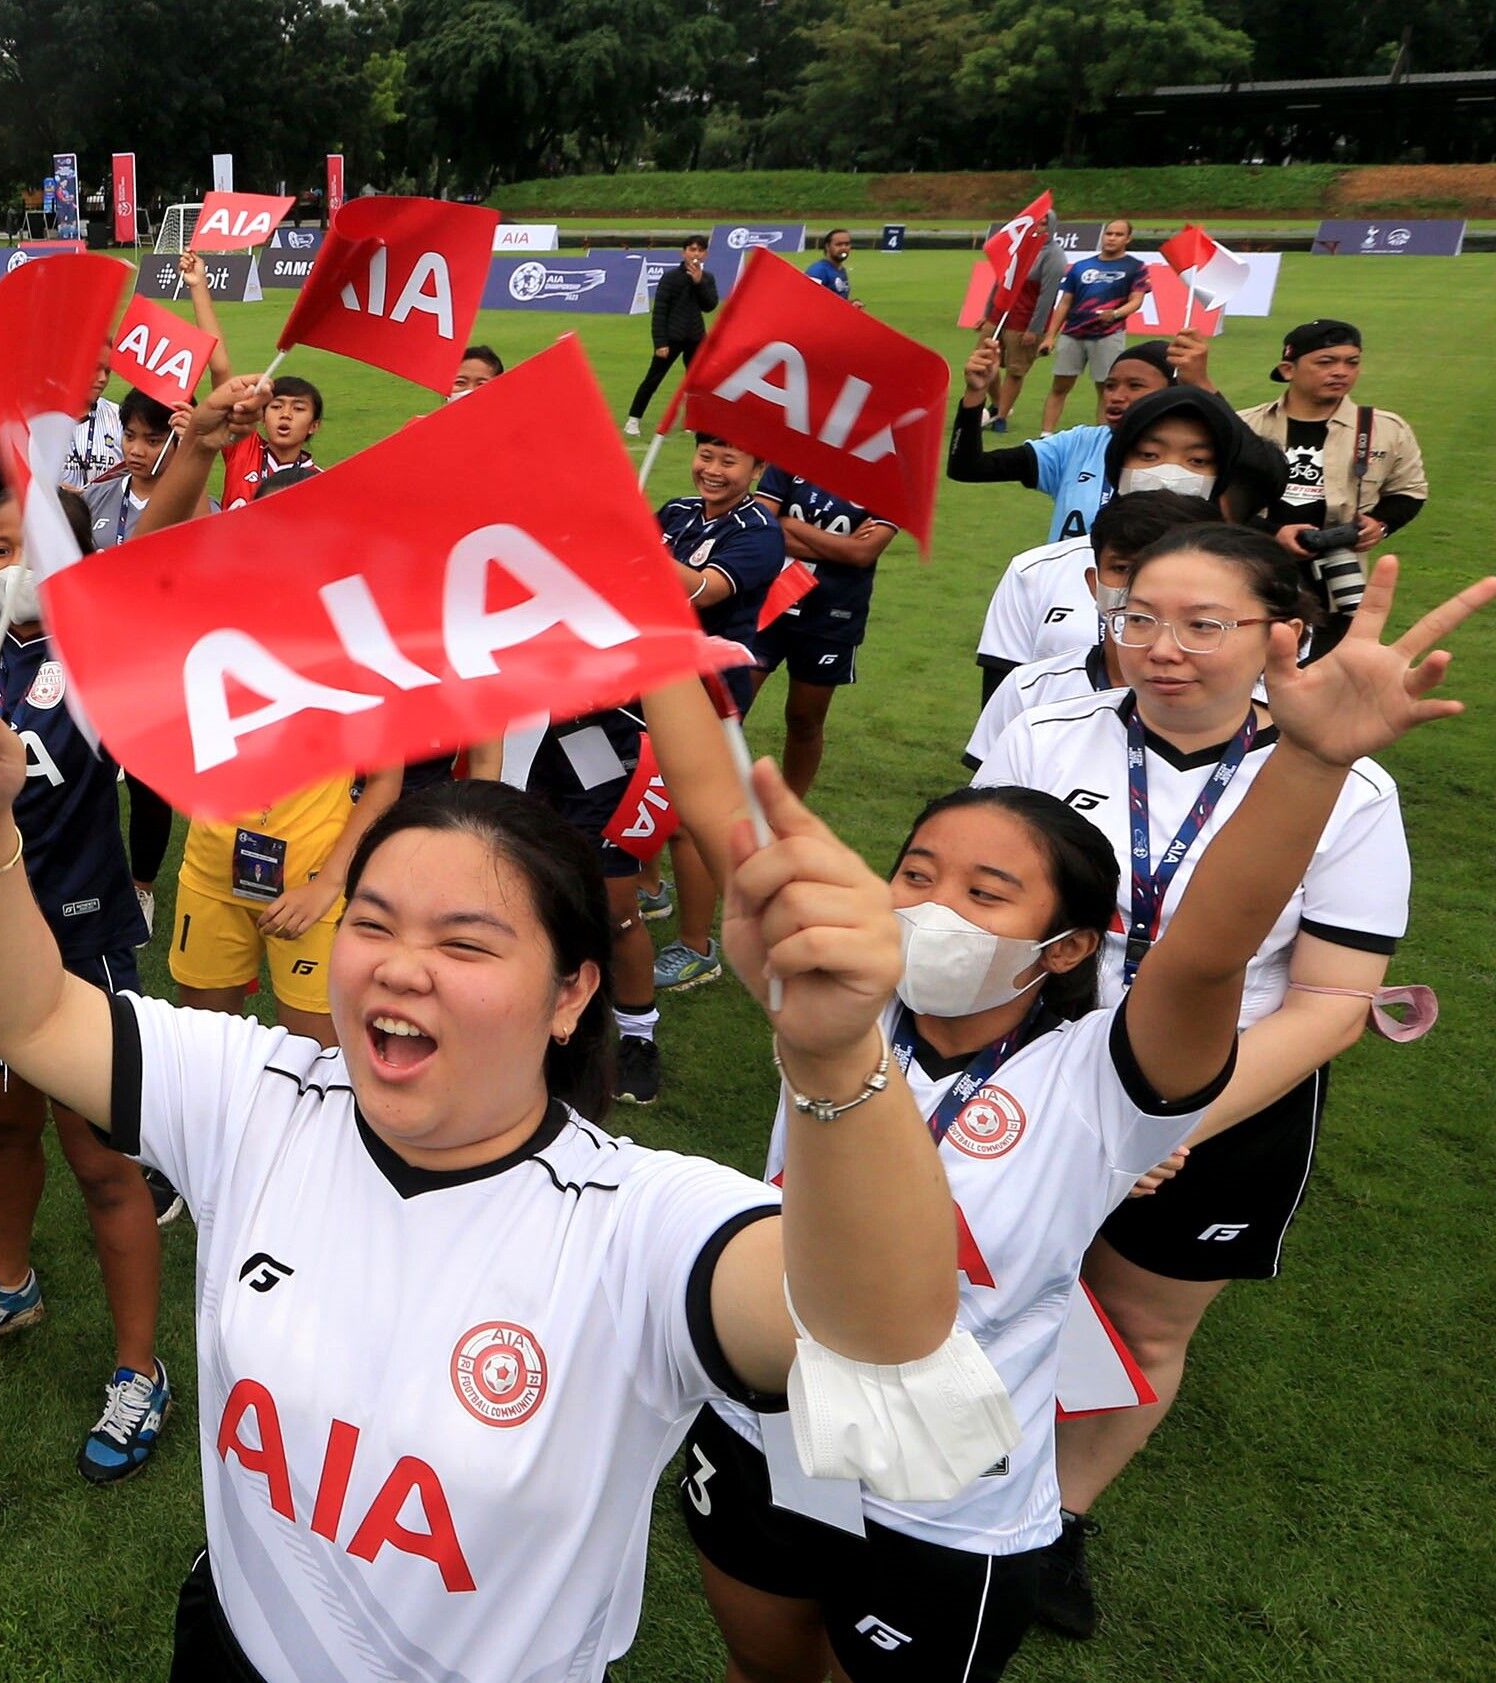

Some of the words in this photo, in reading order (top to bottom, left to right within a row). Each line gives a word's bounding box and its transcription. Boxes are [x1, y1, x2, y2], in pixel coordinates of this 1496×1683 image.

[199, 208, 271, 236] AIA
[502, 232, 529, 244] AIA
[888, 236, 898, 248] 4
[1000, 215, 1035, 291] AI
[274, 261, 314, 275] SAMS
[546, 275, 564, 283] AIA
[341, 243, 454, 340] IA
[117, 324, 193, 390] AIA
[184, 523, 640, 773] AIA
[1163, 839, 1187, 864] AIA
[977, 1133, 1015, 1152] COMMUNITY
[492, 1328, 525, 1348] AIA
[461, 1360, 471, 1369] 20
[529, 1375, 539, 1384] 22
[461, 1375, 492, 1415] FOOTBALL
[491, 1389, 536, 1417] COMMUNITY
[217, 1378, 477, 1593] AIA
